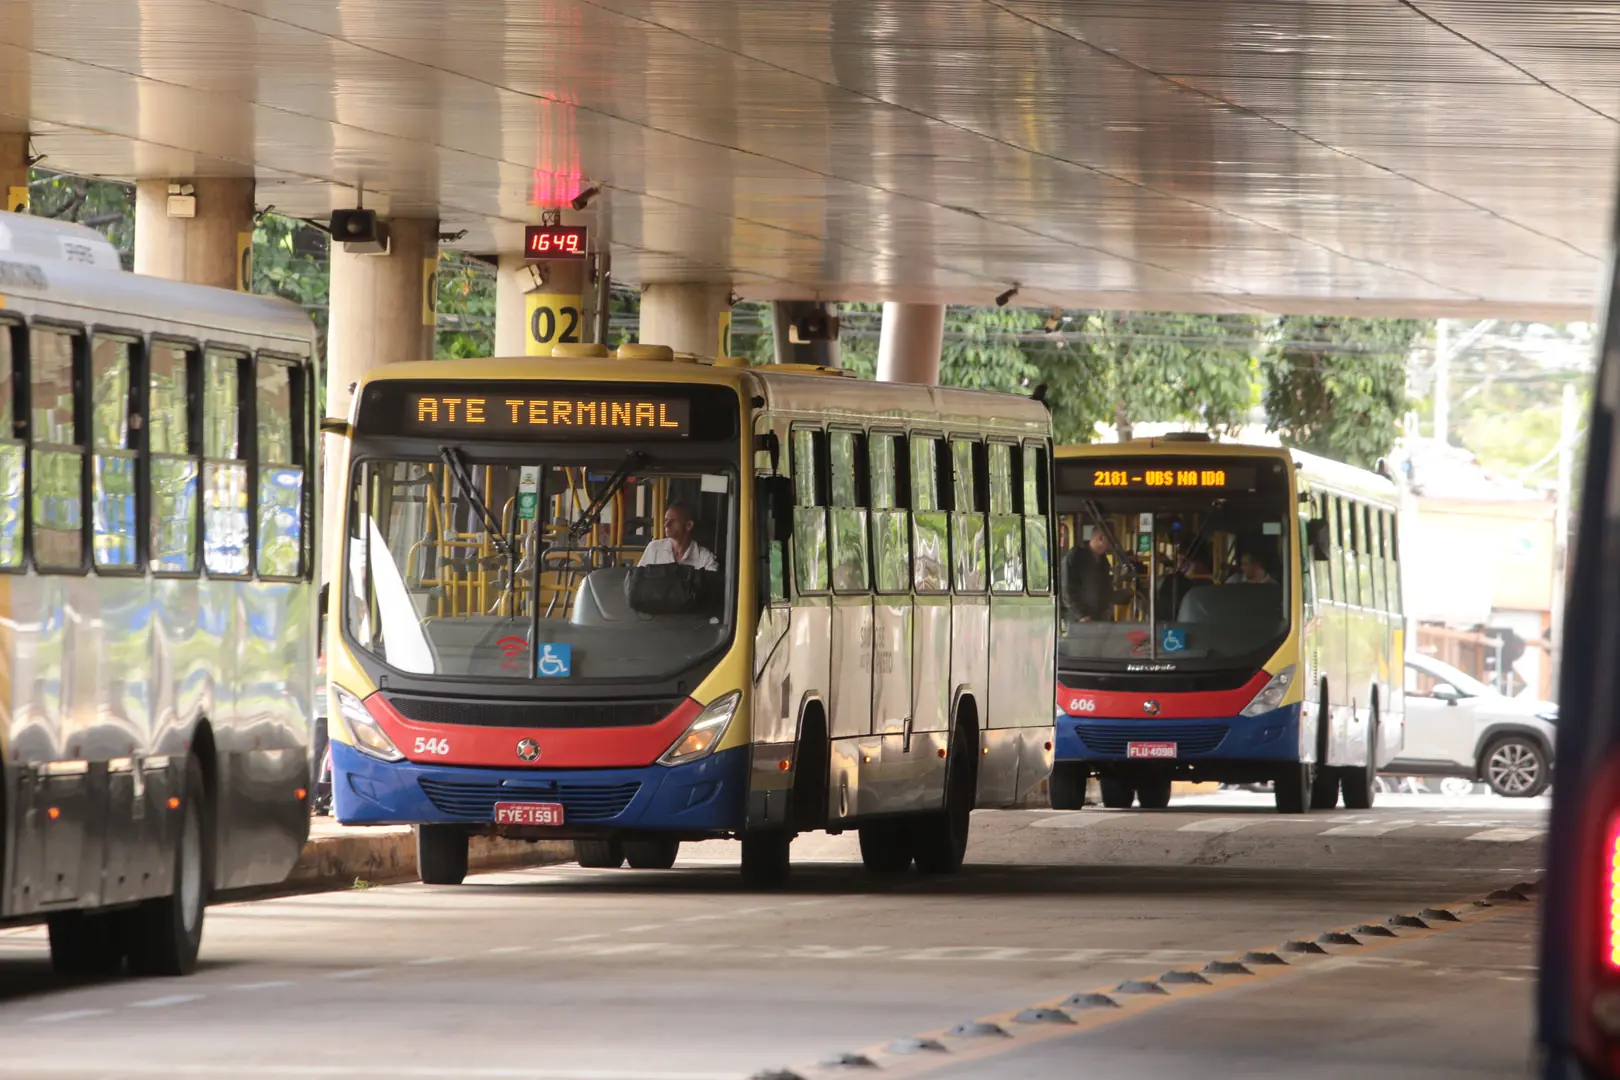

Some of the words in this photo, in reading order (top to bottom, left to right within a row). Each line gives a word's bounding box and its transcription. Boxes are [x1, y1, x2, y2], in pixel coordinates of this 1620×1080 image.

[531, 306, 579, 344] 02
[418, 397, 486, 423] ATE
[505, 399, 679, 428] TERMINAL
[1094, 469, 1129, 487] 2181
[1145, 469, 1174, 487] UBS
[1201, 470, 1225, 486] IDA
[1070, 698, 1096, 712] 606
[413, 736, 450, 756] 546
